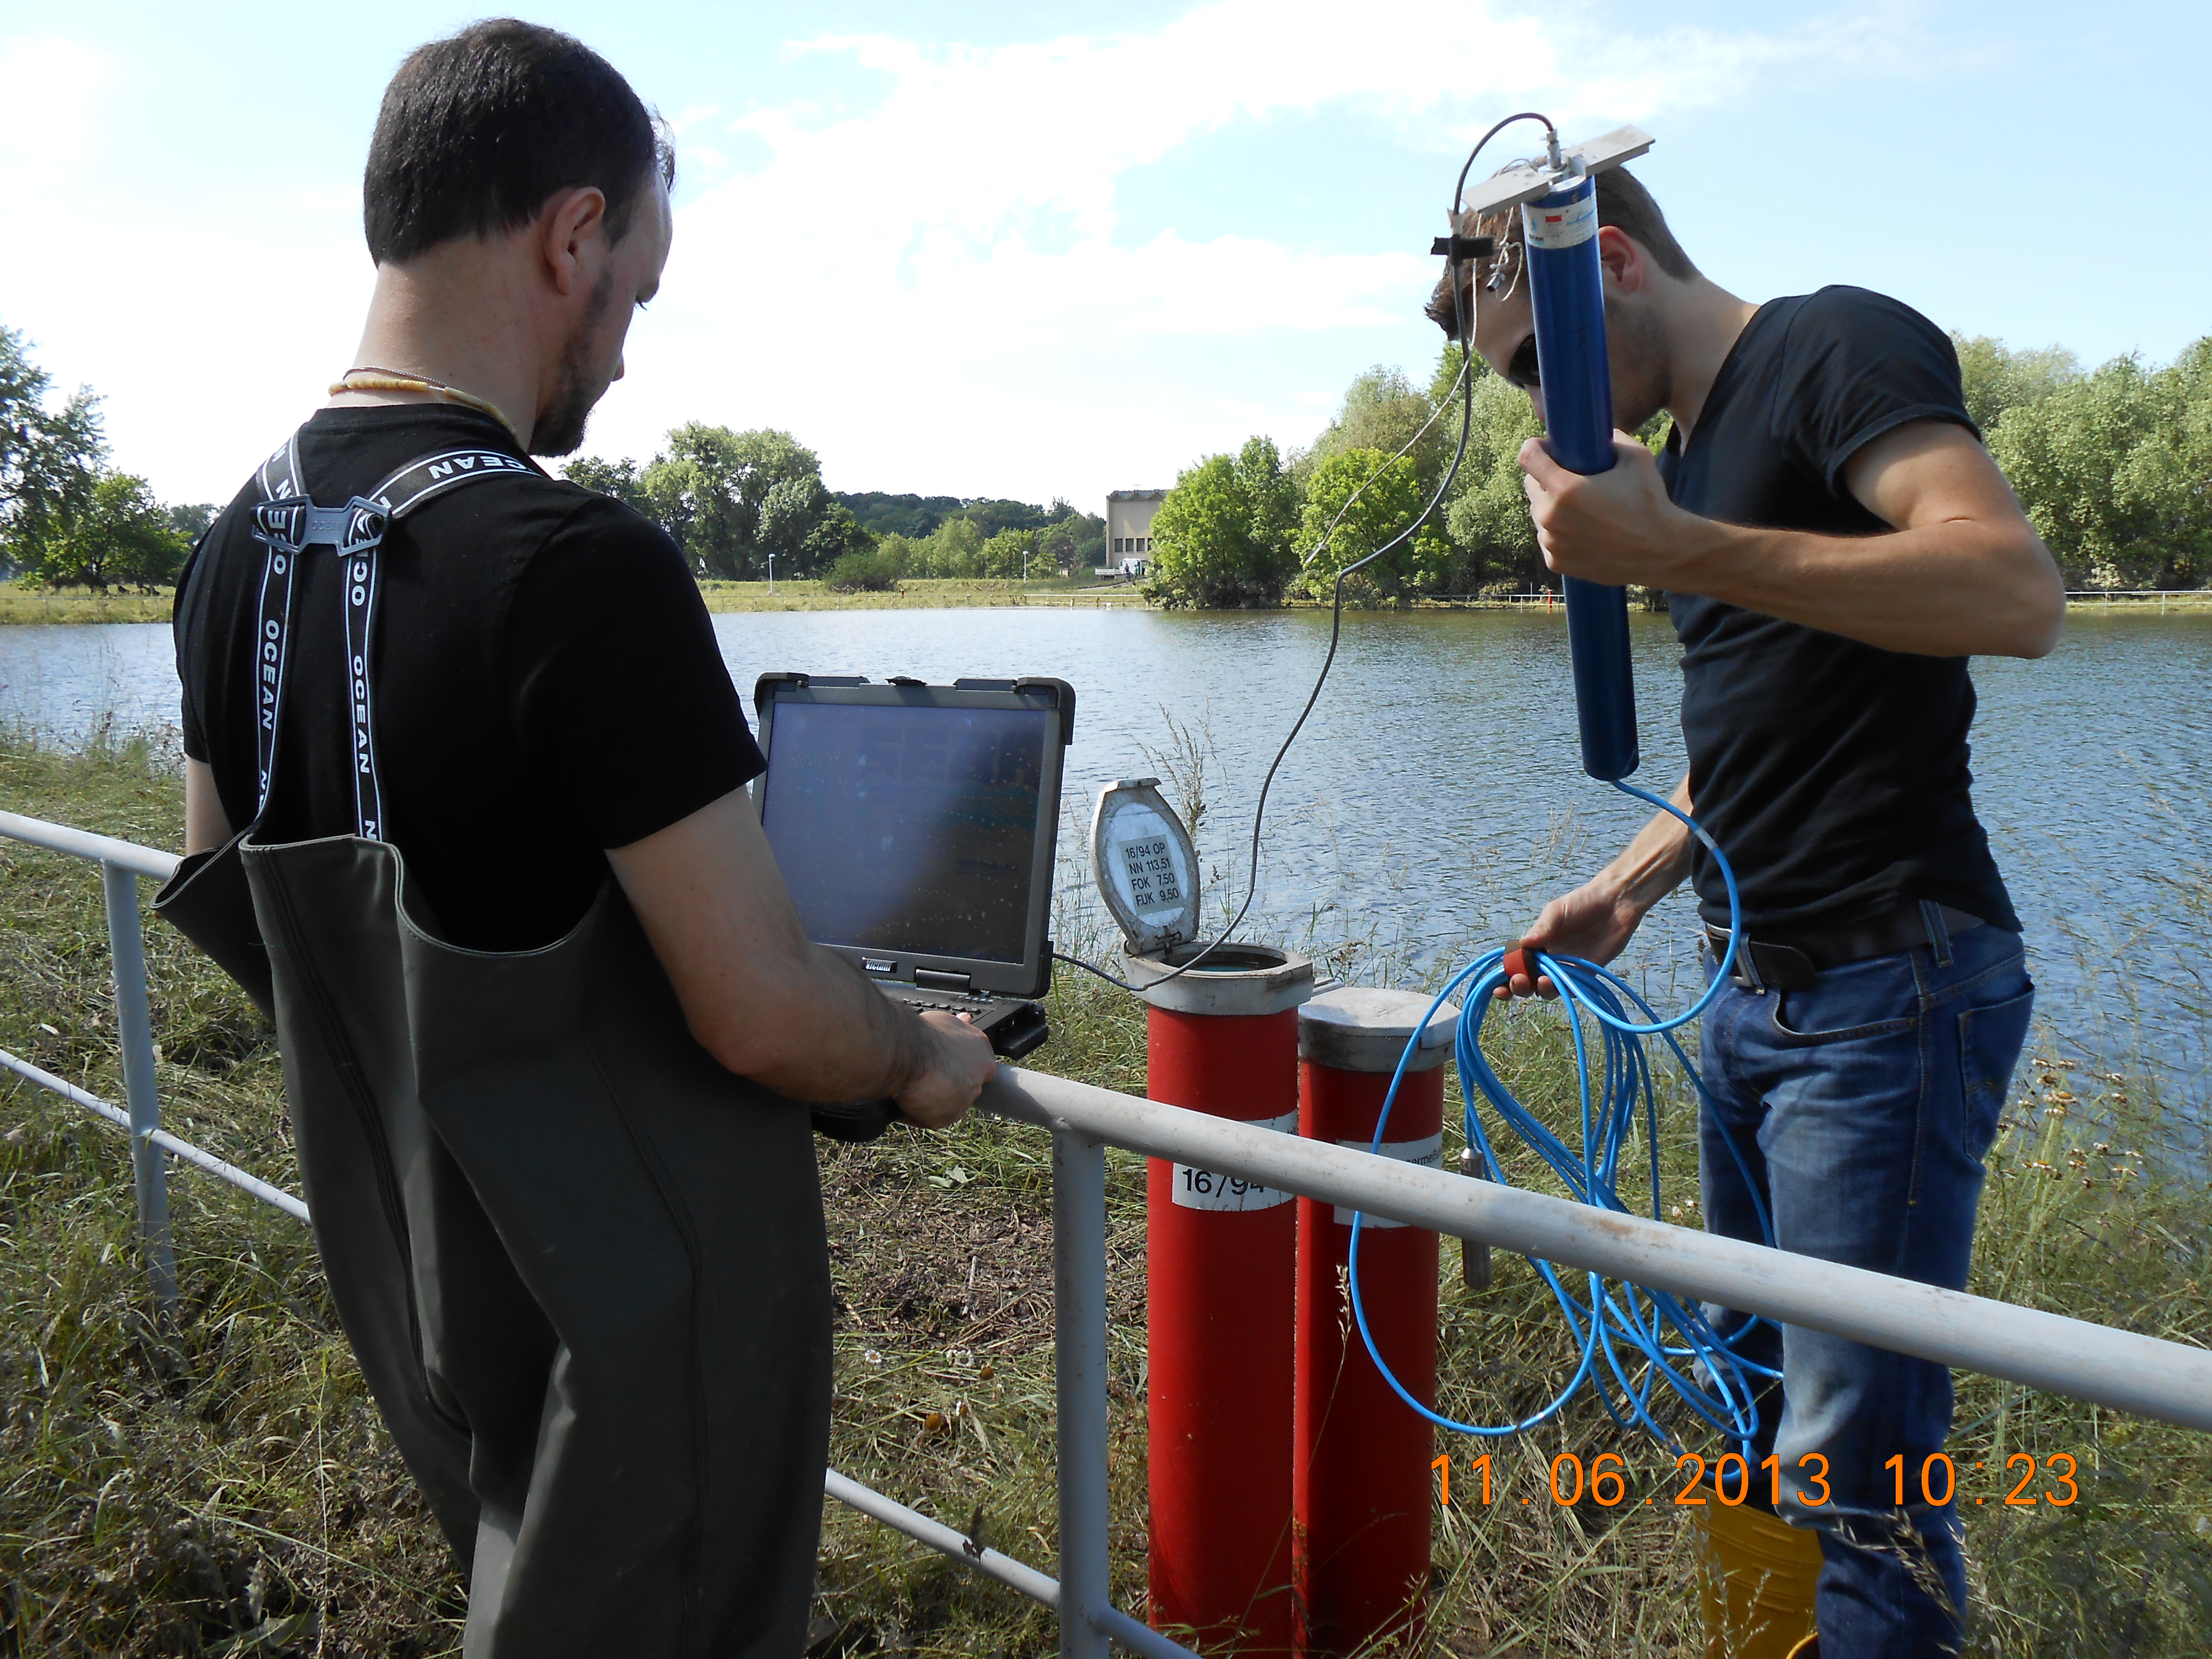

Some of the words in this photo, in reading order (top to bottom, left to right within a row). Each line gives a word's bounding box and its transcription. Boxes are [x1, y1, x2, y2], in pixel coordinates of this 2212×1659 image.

[429, 456, 527, 479] CEAN
[263, 619, 279, 730] OCEAN
[354, 655, 370, 774] OCEAN
[1125, 845, 1150, 859] 16/94
[1153, 842, 1165, 854] OP
[1129, 862, 1143, 874] NN
[1146, 857, 1171, 872] 113,51
[1131, 877, 1151, 890] FOK
[1156, 873, 1175, 887] 7,50
[1159, 888, 1179, 902] 9,50
